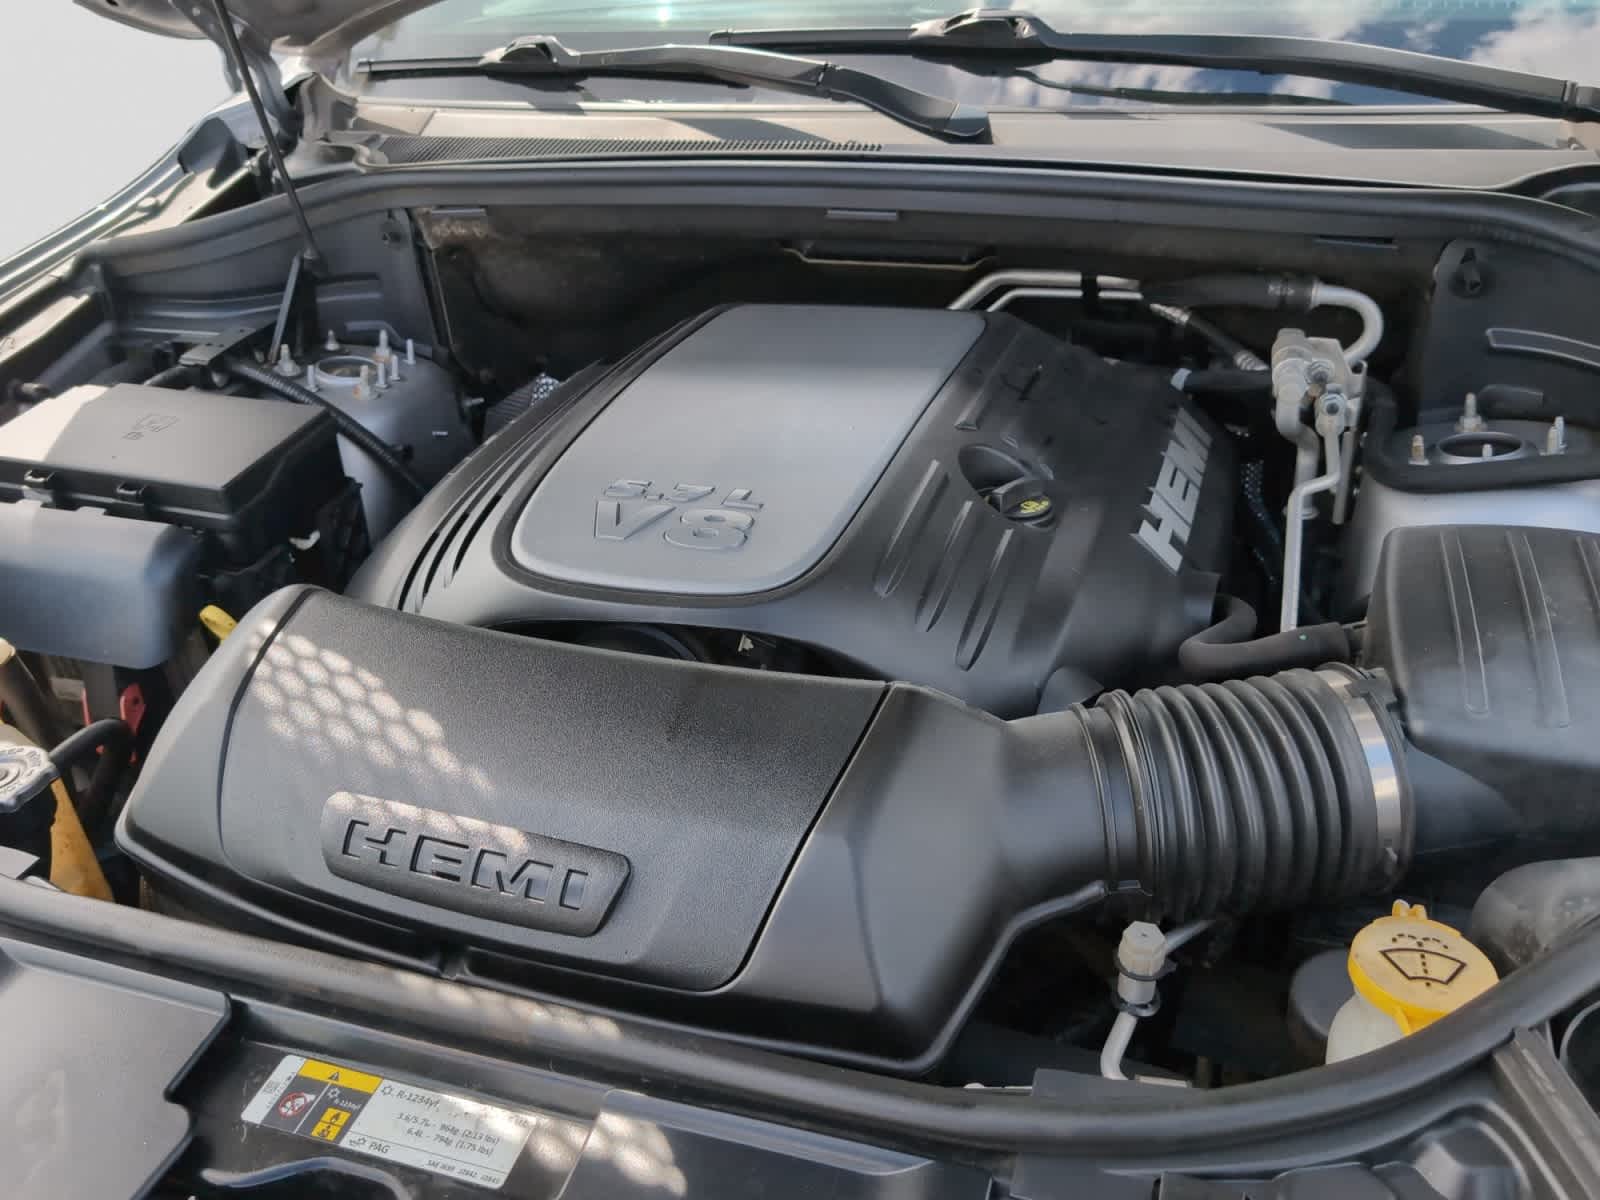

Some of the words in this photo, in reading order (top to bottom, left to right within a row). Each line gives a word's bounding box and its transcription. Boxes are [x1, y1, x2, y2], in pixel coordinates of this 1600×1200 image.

[593, 499, 756, 550] V8
[1129, 407, 1213, 576] HEMI
[342, 819, 589, 911] HEMI
[368, 1141, 391, 1154] PAG
